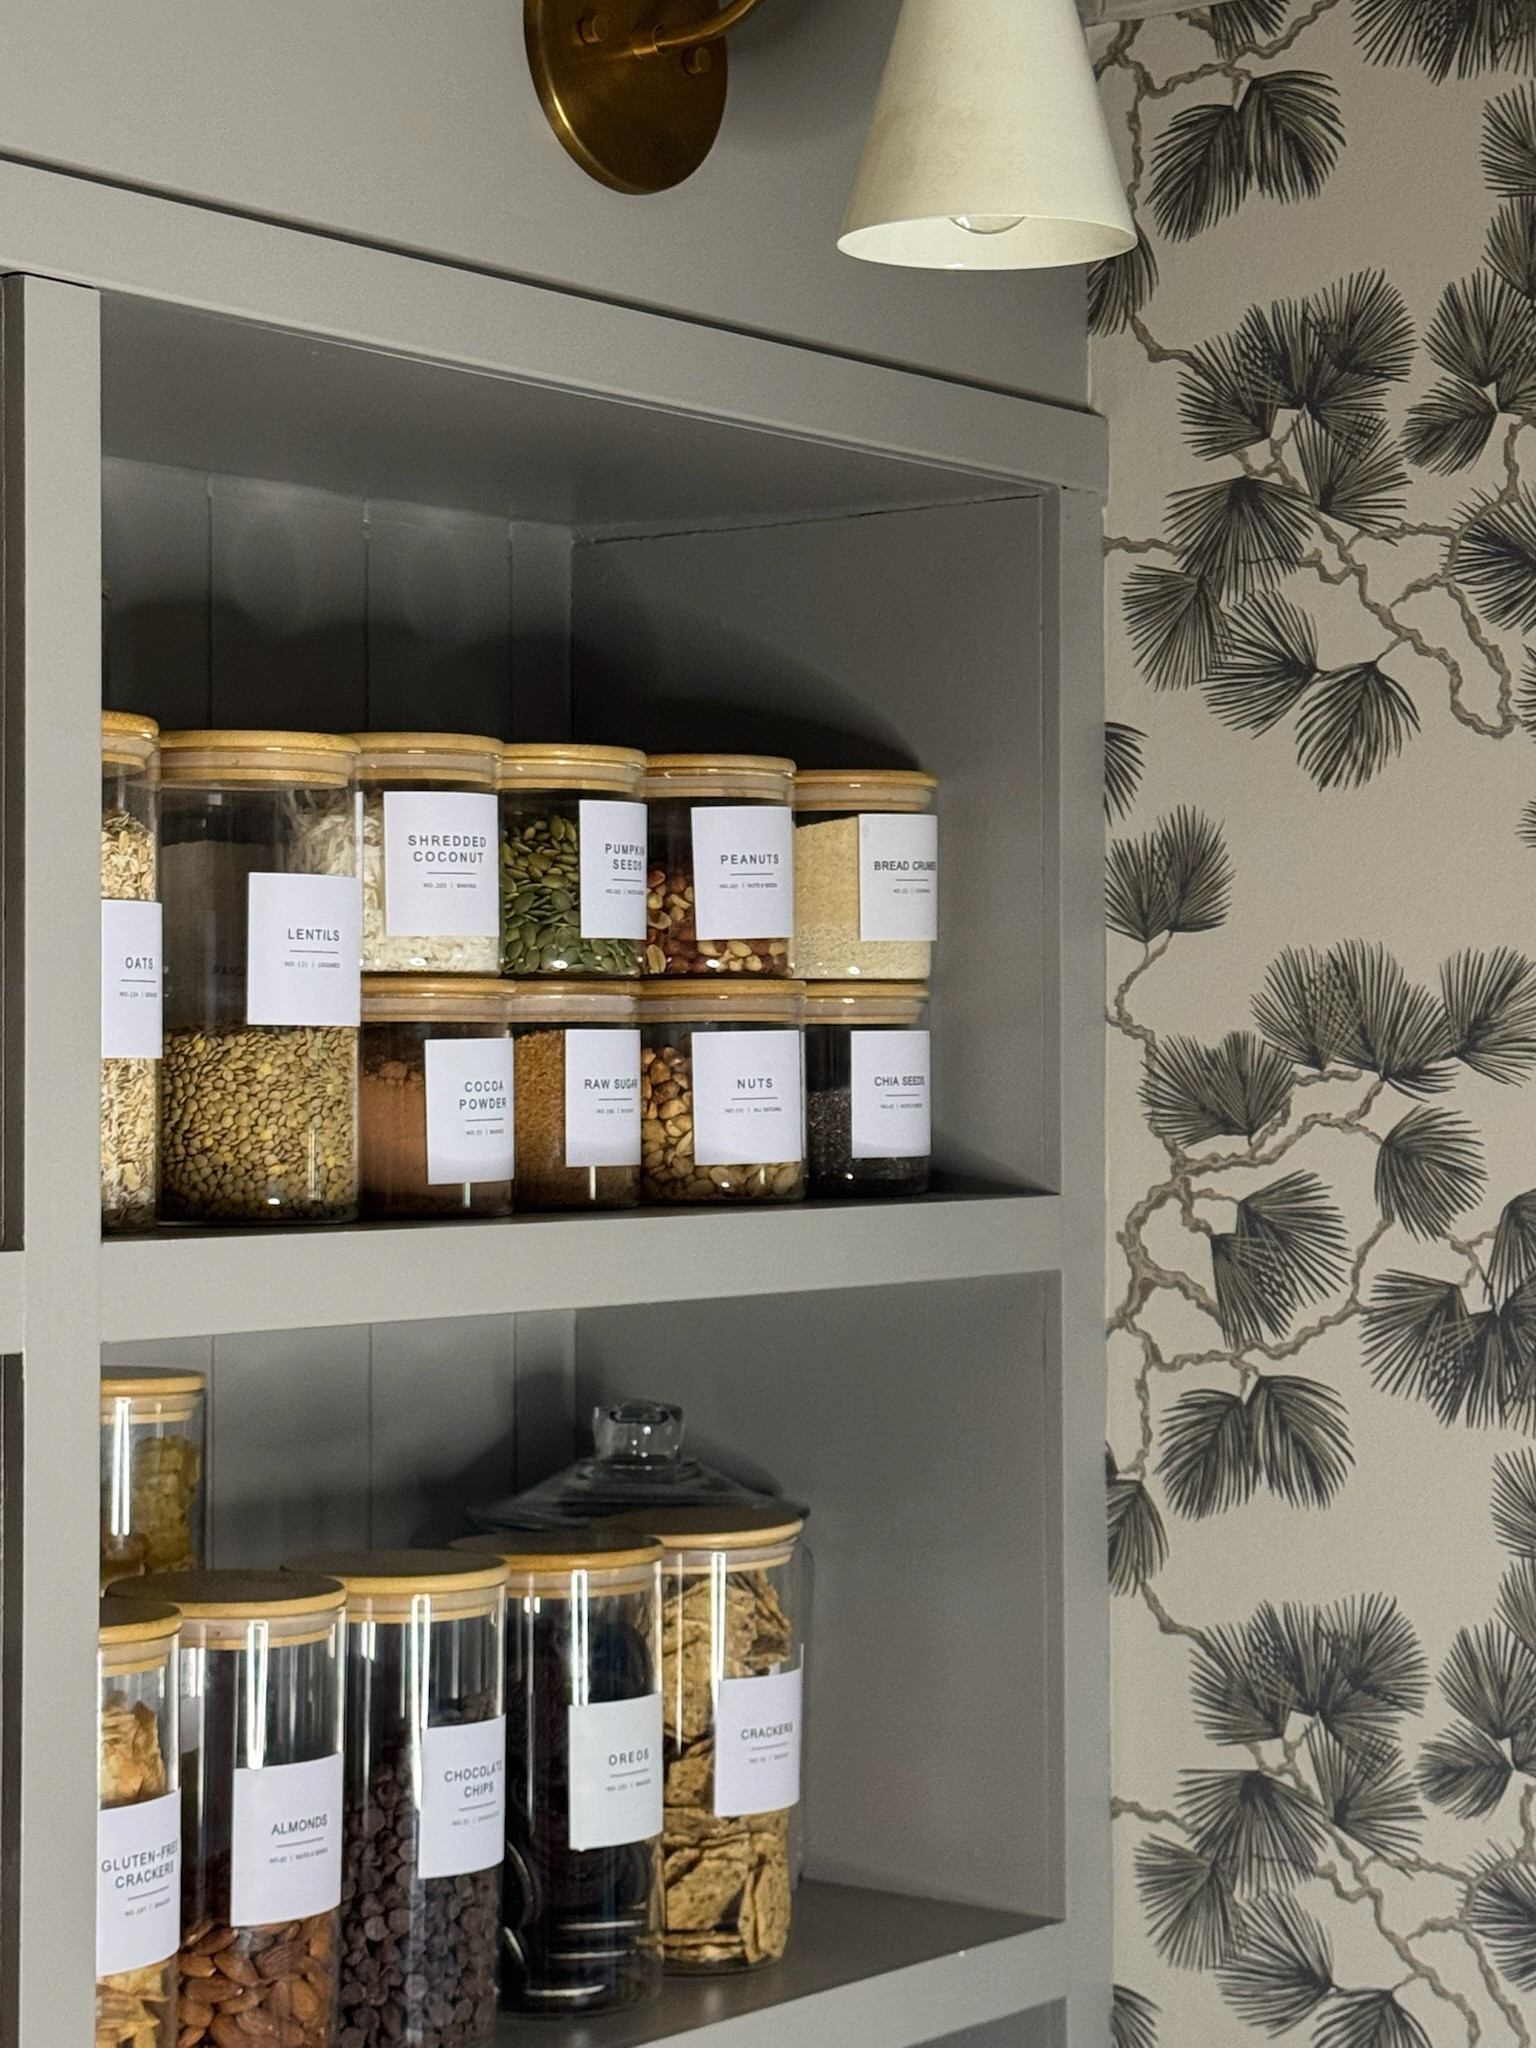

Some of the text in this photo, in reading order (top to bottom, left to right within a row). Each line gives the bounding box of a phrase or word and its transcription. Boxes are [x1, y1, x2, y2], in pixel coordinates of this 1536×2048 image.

[408, 835, 487, 848] SHREDDED
[413, 851, 484, 864] COCONUT
[720, 853, 780, 865] PEANUTS
[612, 858, 642, 872] SEEDS
[874, 860, 910, 872] BREAD
[288, 927, 341, 942] LENTILS
[125, 956, 154, 970] OATS
[464, 1080, 505, 1093] COCOA
[584, 1078, 638, 1091] RAW SUGAR
[736, 1077, 774, 1090] NUTS
[874, 1075, 926, 1087] CHIA SEEDS
[459, 1097, 507, 1111] POWDER
[741, 1721, 793, 1741] CRACKERS
[608, 1747, 650, 1767] OREOS
[463, 1780, 494, 1799] CHIPS
[270, 1813, 328, 1837] ALMONDS
[114, 1860, 175, 1890] CRACKERS
